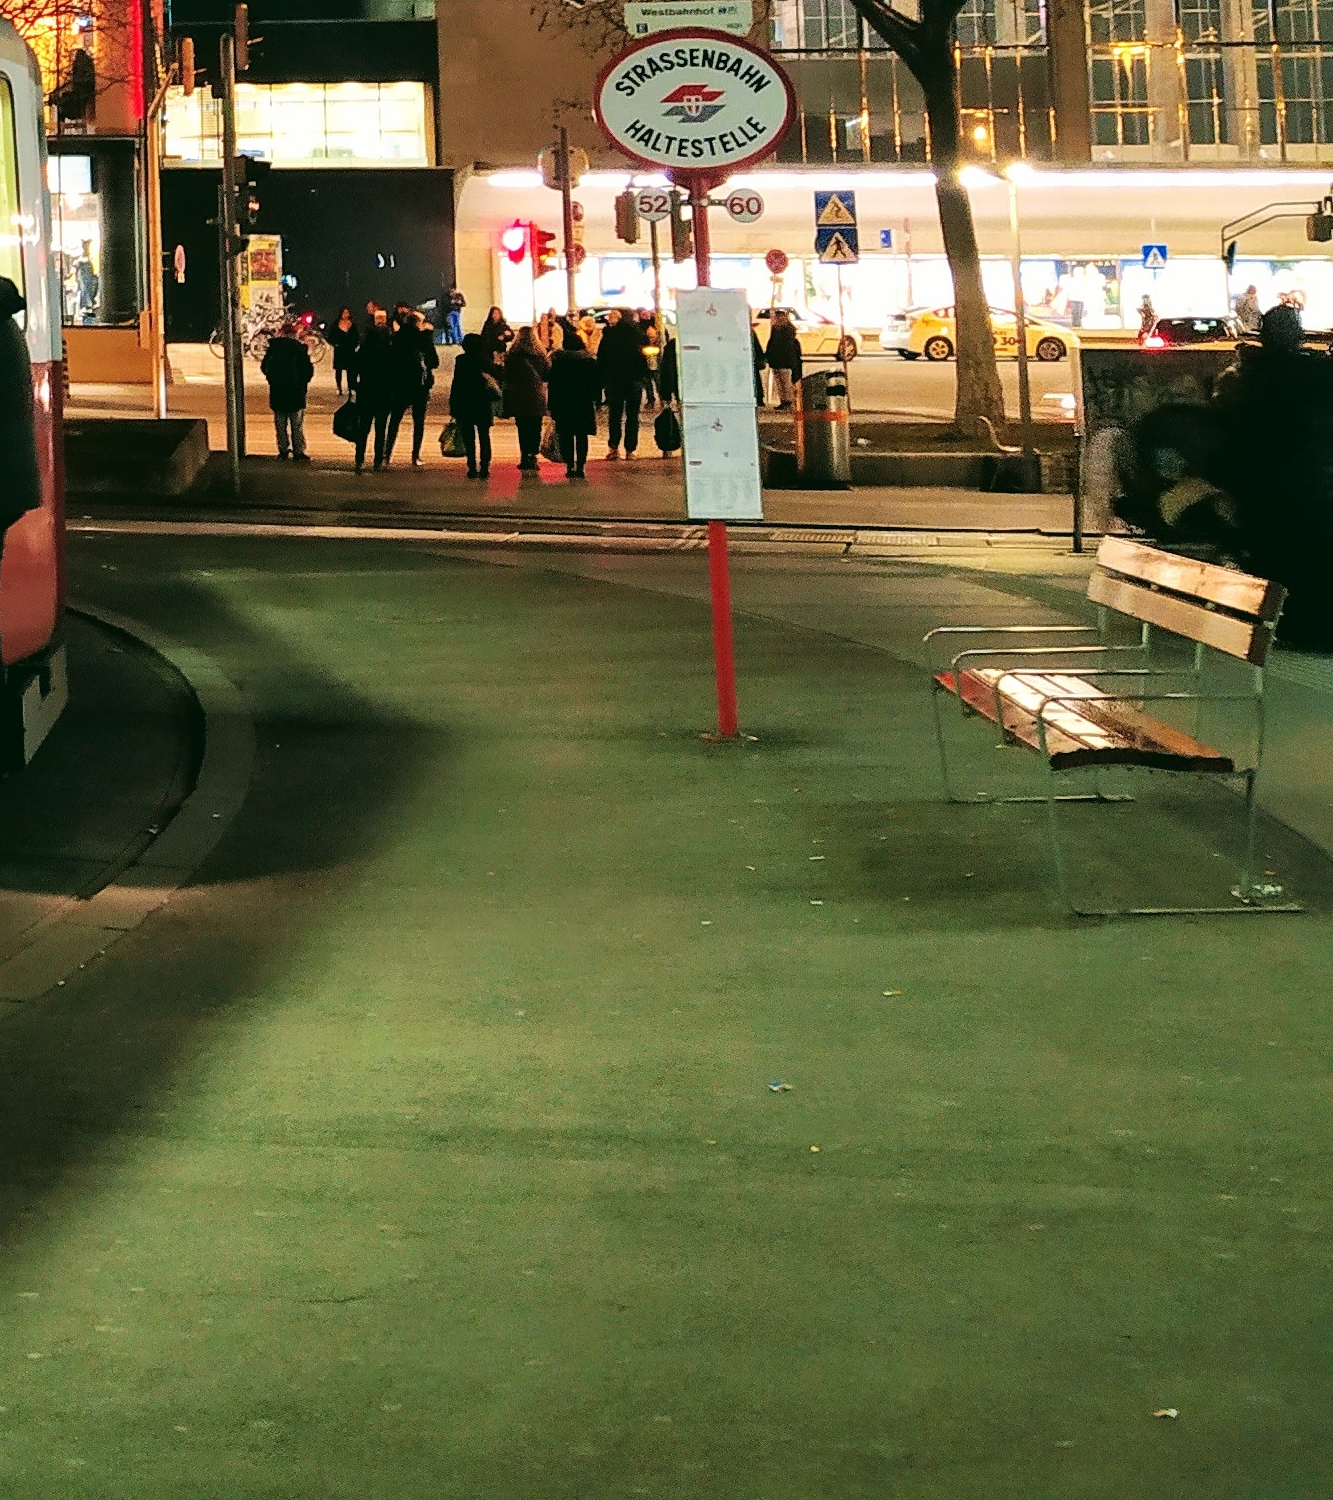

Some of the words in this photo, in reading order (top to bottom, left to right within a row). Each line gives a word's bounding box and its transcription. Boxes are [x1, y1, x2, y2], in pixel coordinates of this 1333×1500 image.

[614, 47, 772, 98] STRASSENBAHN
[623, 115, 768, 159] HALTESTELLE
[638, 195, 670, 215] 52
[729, 195, 762, 216] 60
